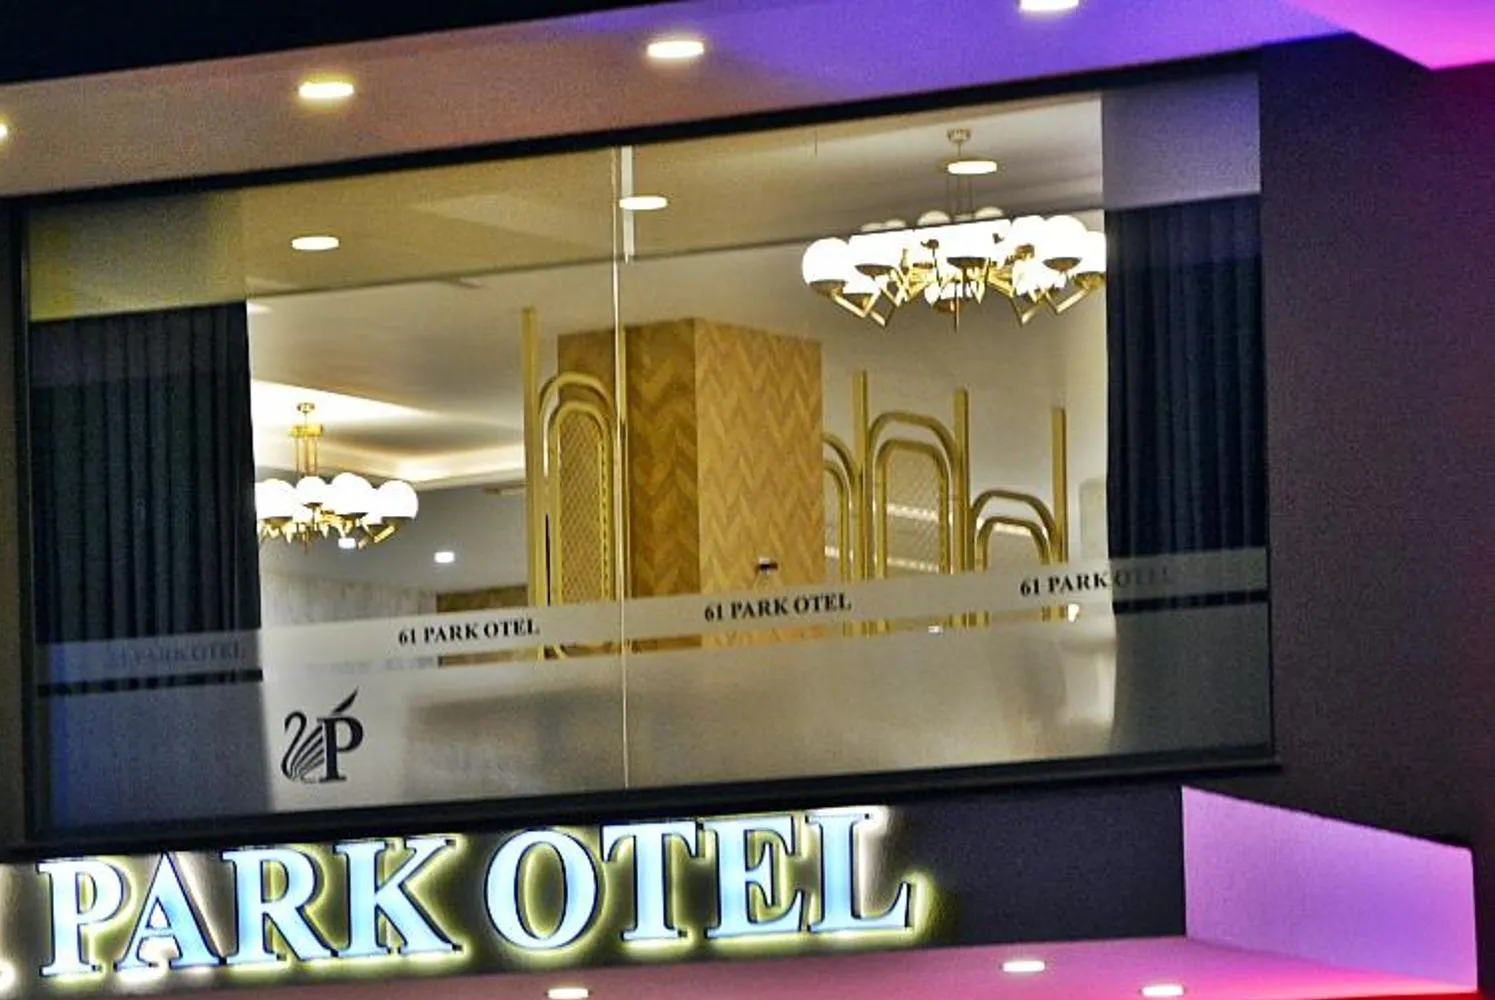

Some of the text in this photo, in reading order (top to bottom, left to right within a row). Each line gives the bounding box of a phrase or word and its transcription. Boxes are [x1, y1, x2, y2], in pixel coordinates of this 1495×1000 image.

[1020, 577, 1040, 597] 61
[1048, 573, 1108, 594] PARK
[704, 591, 853, 622] 61 PARK OTEL
[398, 617, 540, 645] 61 PARK OTEL
[36, 834, 464, 977] PARK
[483, 811, 912, 950] OTEL
